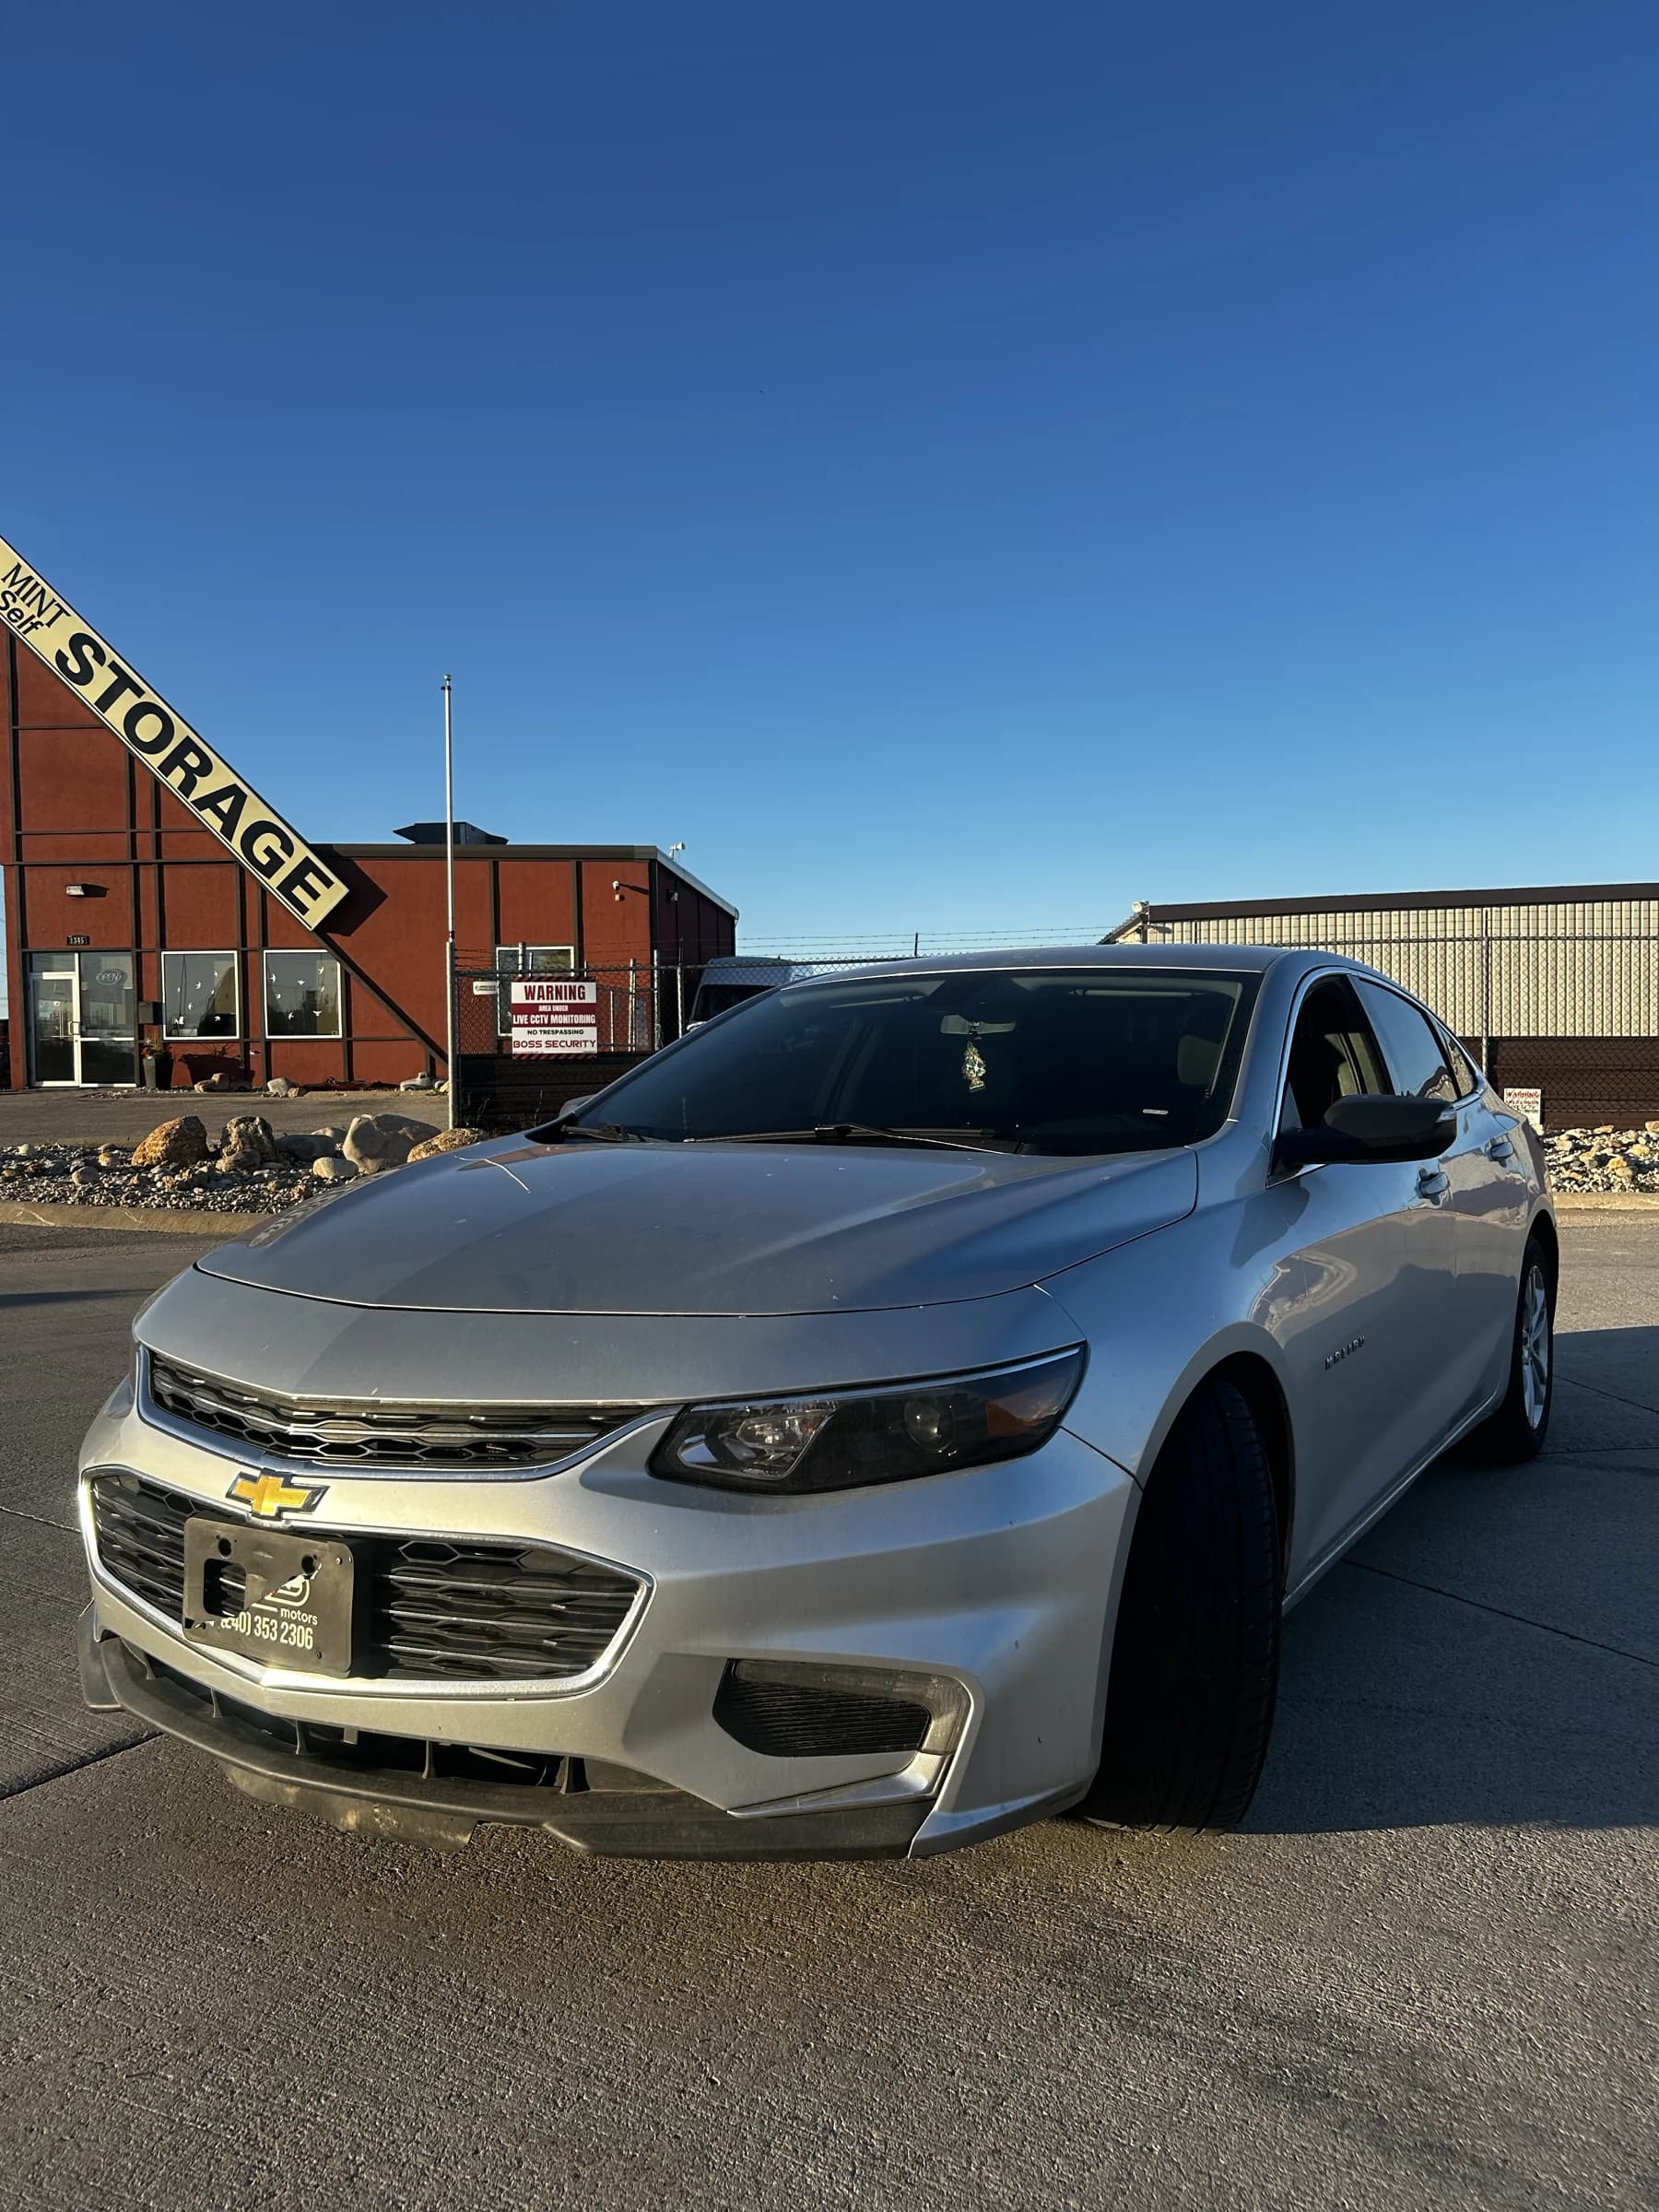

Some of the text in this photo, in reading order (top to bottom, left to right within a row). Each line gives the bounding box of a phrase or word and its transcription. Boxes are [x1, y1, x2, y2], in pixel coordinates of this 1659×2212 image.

[1, 562, 72, 629] MINT
[0, 590, 44, 635] Self
[54, 631, 335, 916] STORAGE
[524, 984, 586, 1001] WARNING
[512, 1014, 596, 1024] LIVE CCTV MONITORING
[512, 1040, 596, 1049] BOSS SECURITY
[280, 1607, 318, 1626] motors
[253, 1615, 278, 1641] 353
[279, 1621, 313, 1650] 2306
